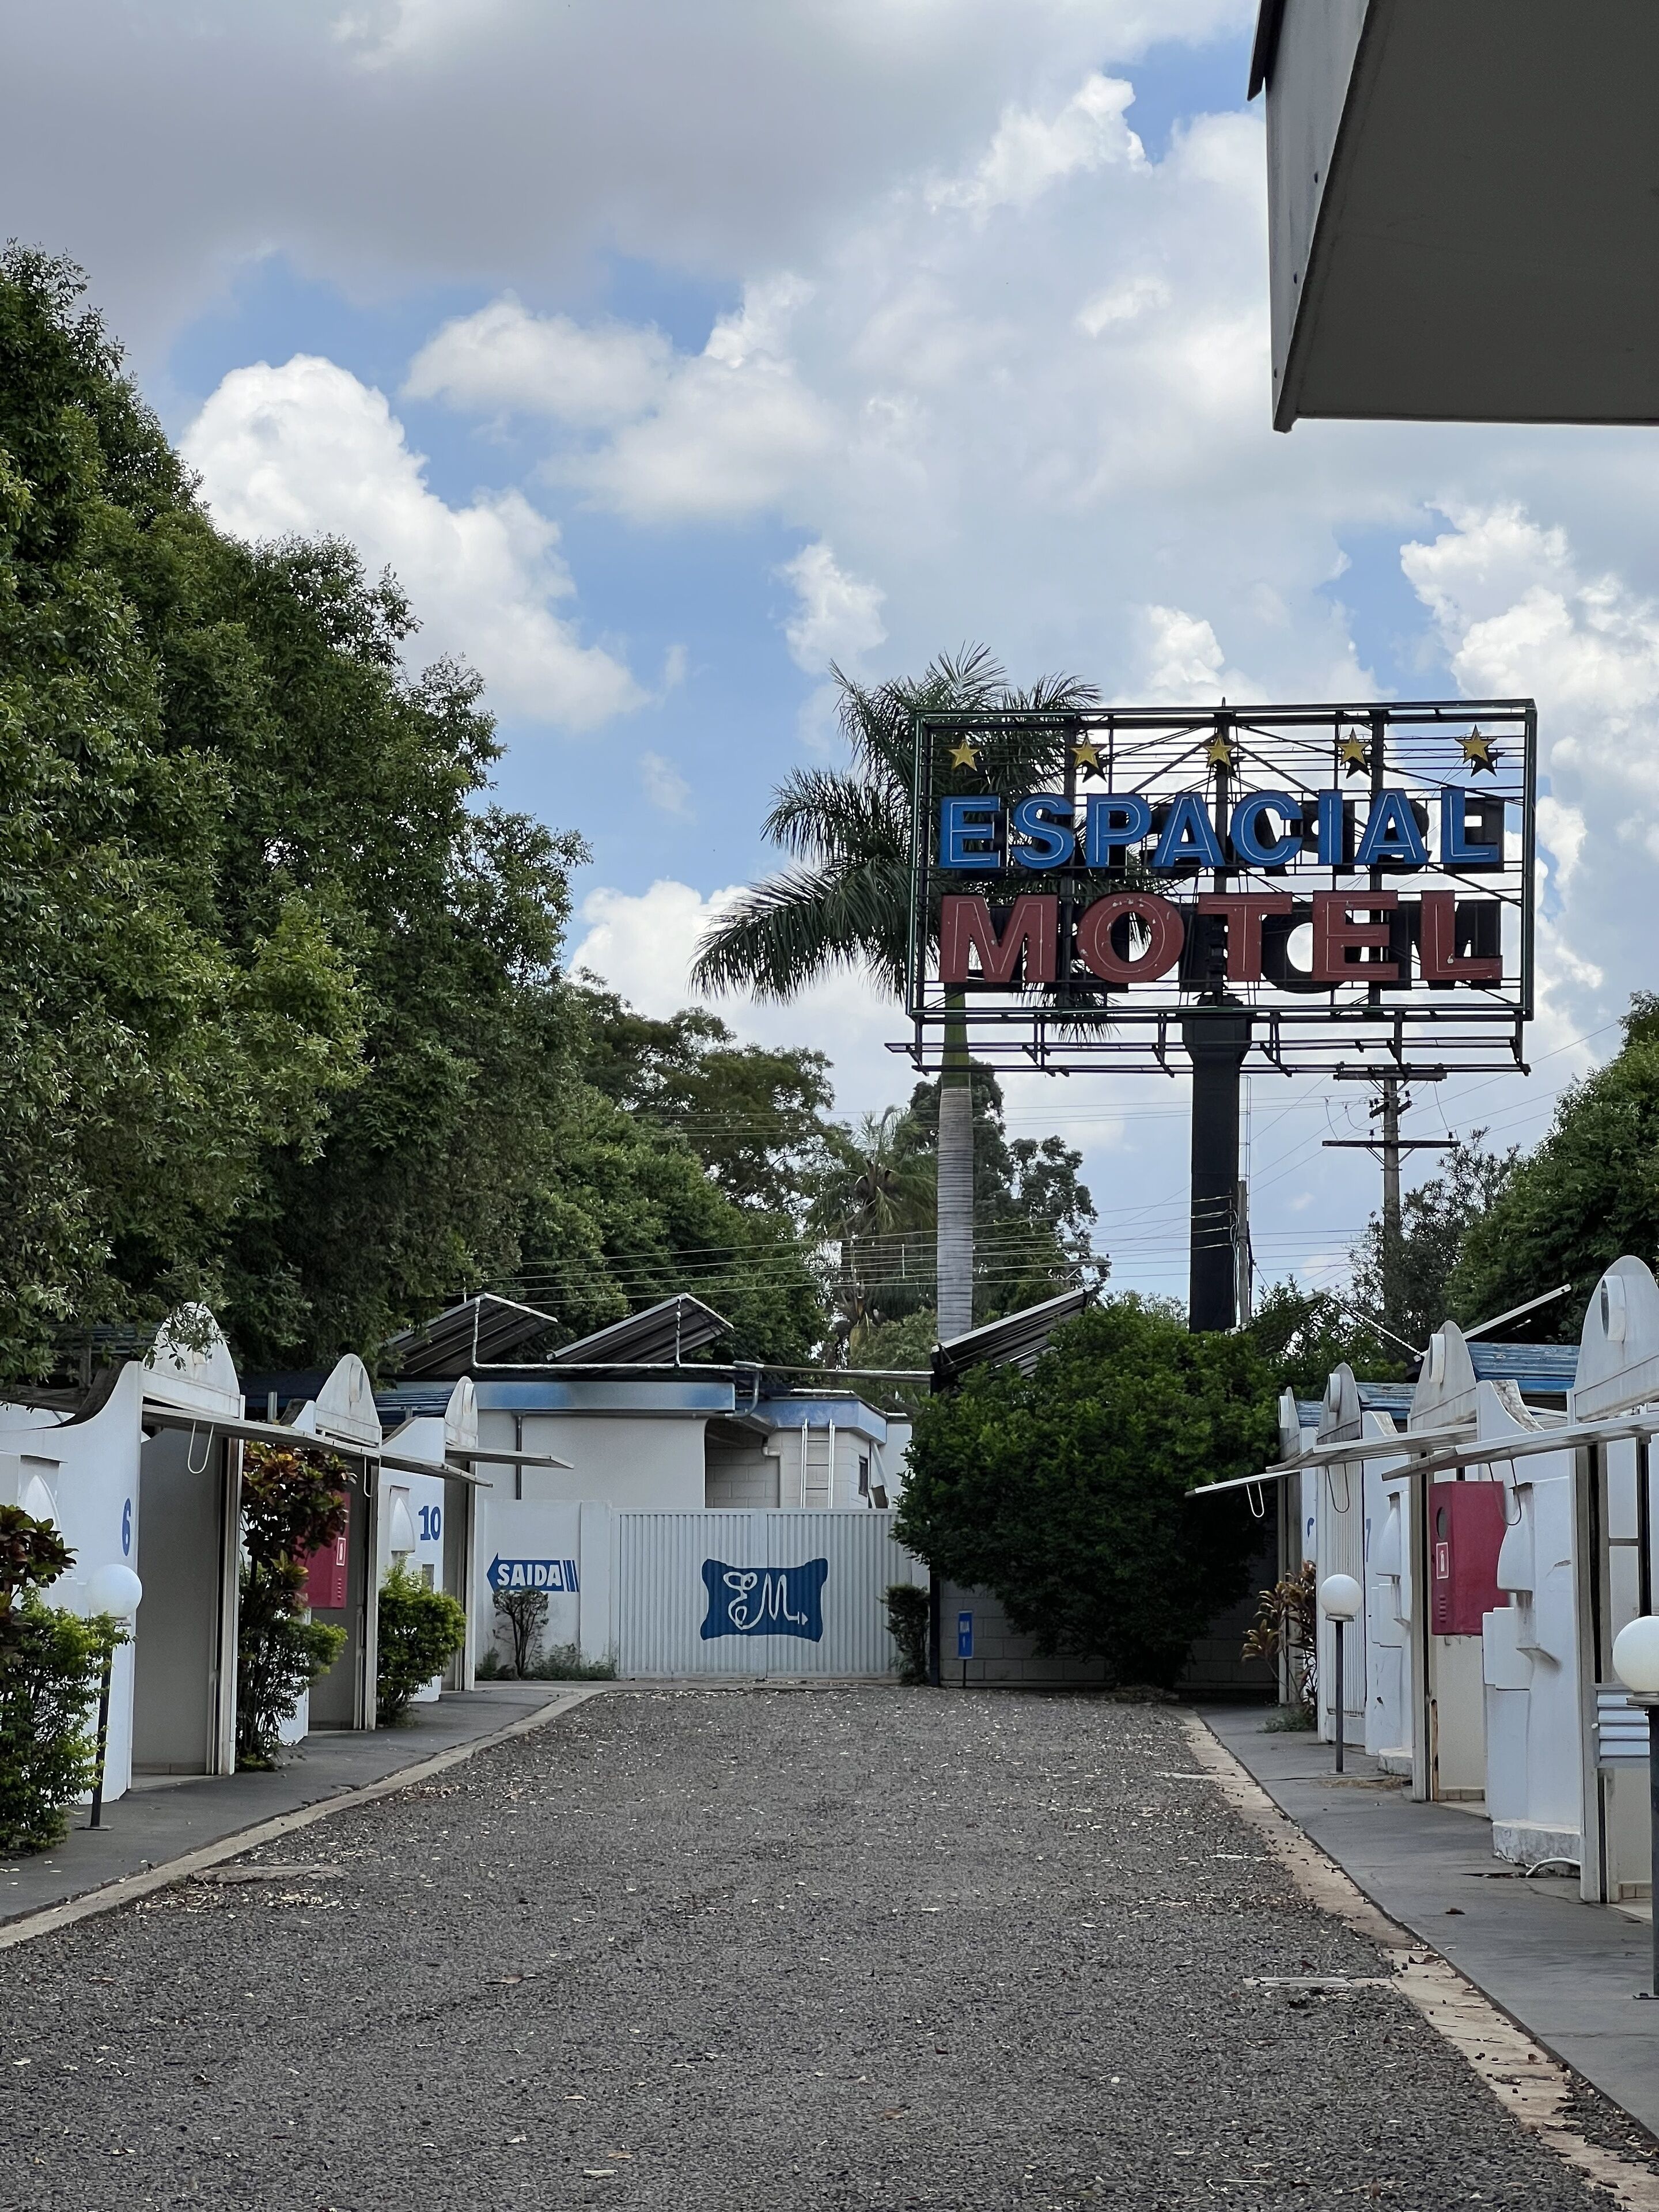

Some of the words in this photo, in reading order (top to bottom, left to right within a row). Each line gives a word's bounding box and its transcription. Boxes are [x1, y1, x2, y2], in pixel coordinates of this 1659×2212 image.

[941, 788, 1498, 869] ESPACIAL
[941, 890, 1503, 982] MOTEL
[122, 1498, 131, 1556] 6
[418, 1505, 441, 1540] 10
[497, 1563, 562, 1586] SAIDA
